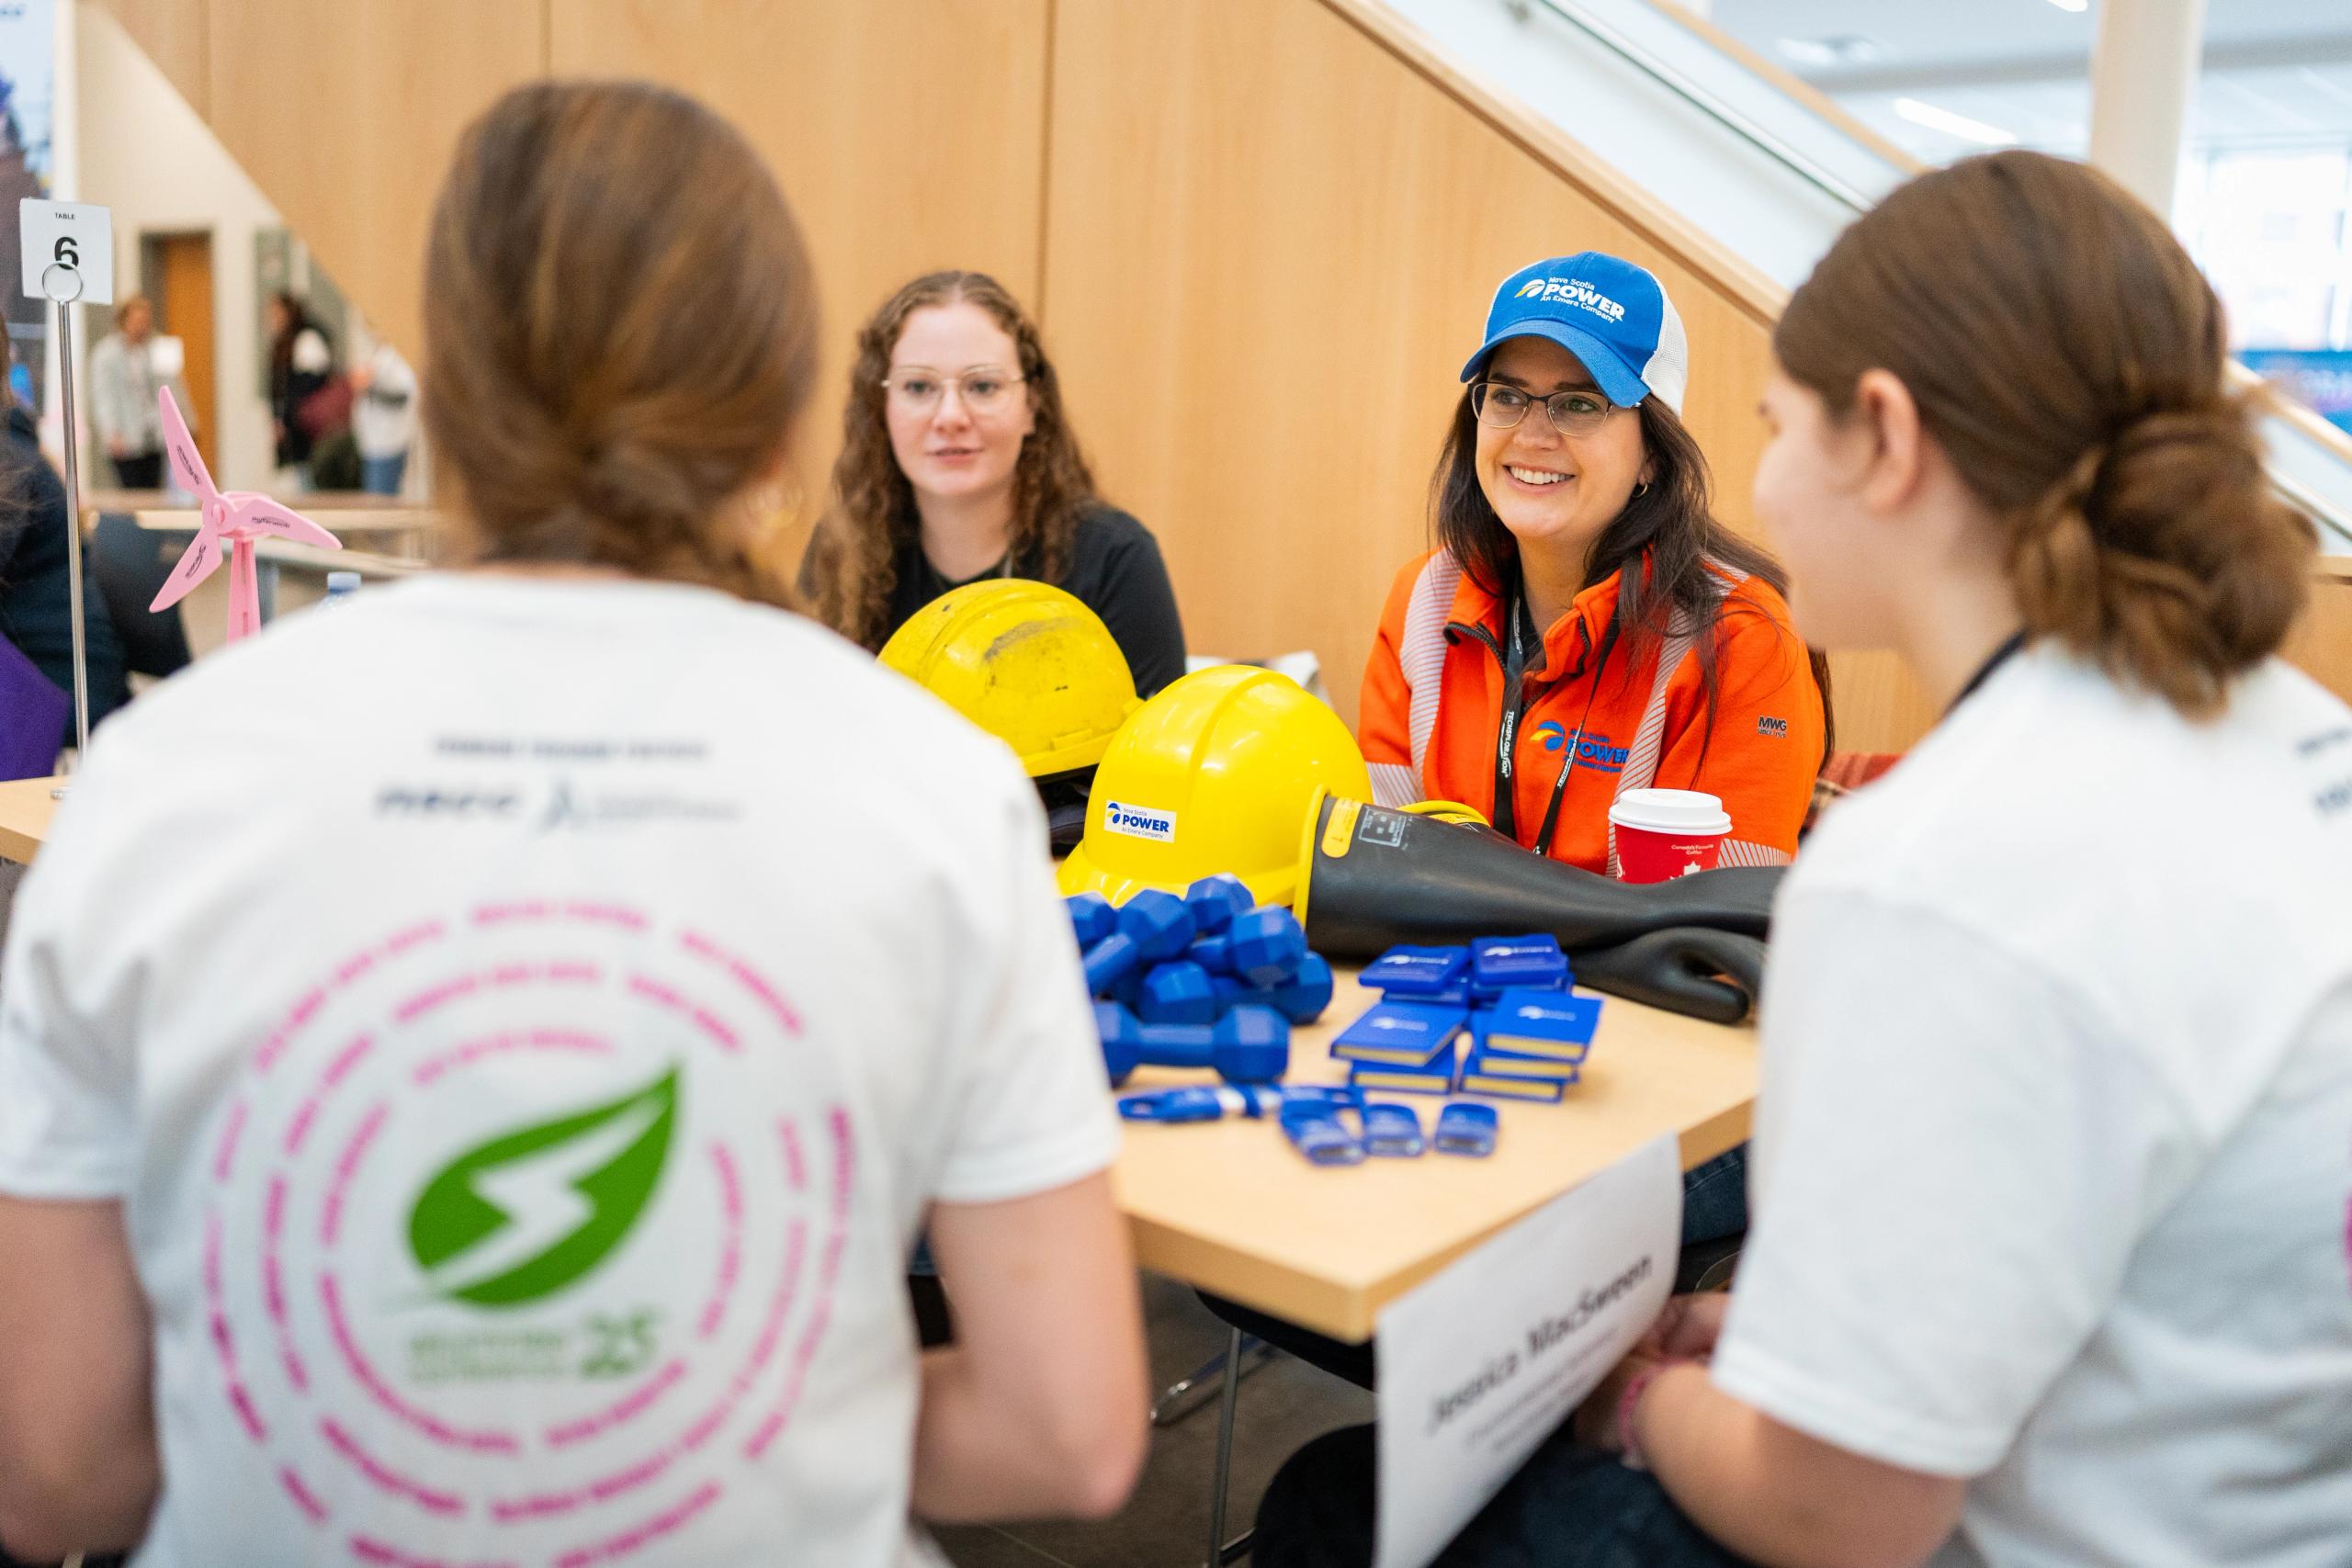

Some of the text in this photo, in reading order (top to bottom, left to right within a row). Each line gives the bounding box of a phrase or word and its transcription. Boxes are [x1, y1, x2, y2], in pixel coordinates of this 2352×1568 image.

[54, 236, 79, 270] 6
[1570, 278, 1595, 290] Scotia
[1544, 283, 1625, 321] POWER
[1553, 295, 1579, 307] Emera
[1580, 302, 1615, 323] Company
[1758, 716, 1787, 731] MWG
[1123, 814, 1170, 832] POWER
